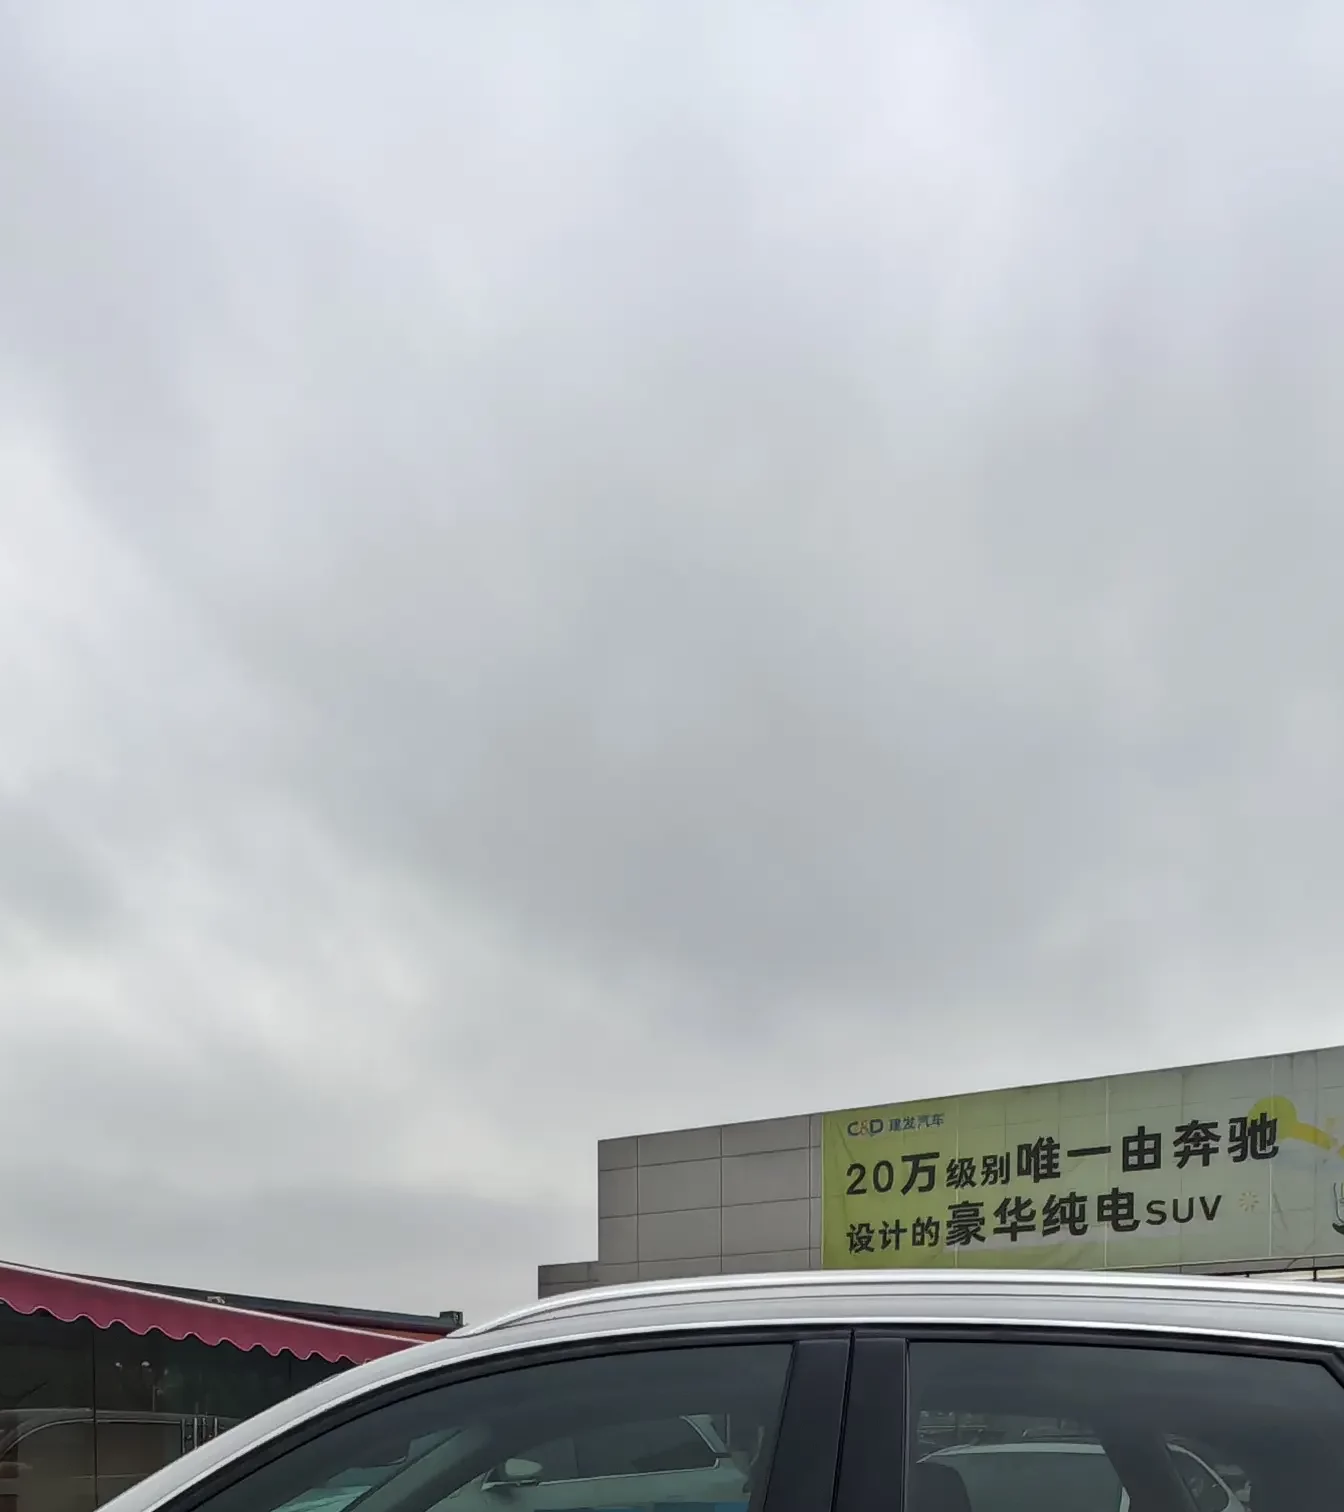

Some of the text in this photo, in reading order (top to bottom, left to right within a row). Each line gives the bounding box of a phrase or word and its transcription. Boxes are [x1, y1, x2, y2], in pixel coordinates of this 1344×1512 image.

[847, 1119, 884, 1136] C&D
[845, 1112, 1279, 1196] 20万级别唯一由奔驰
